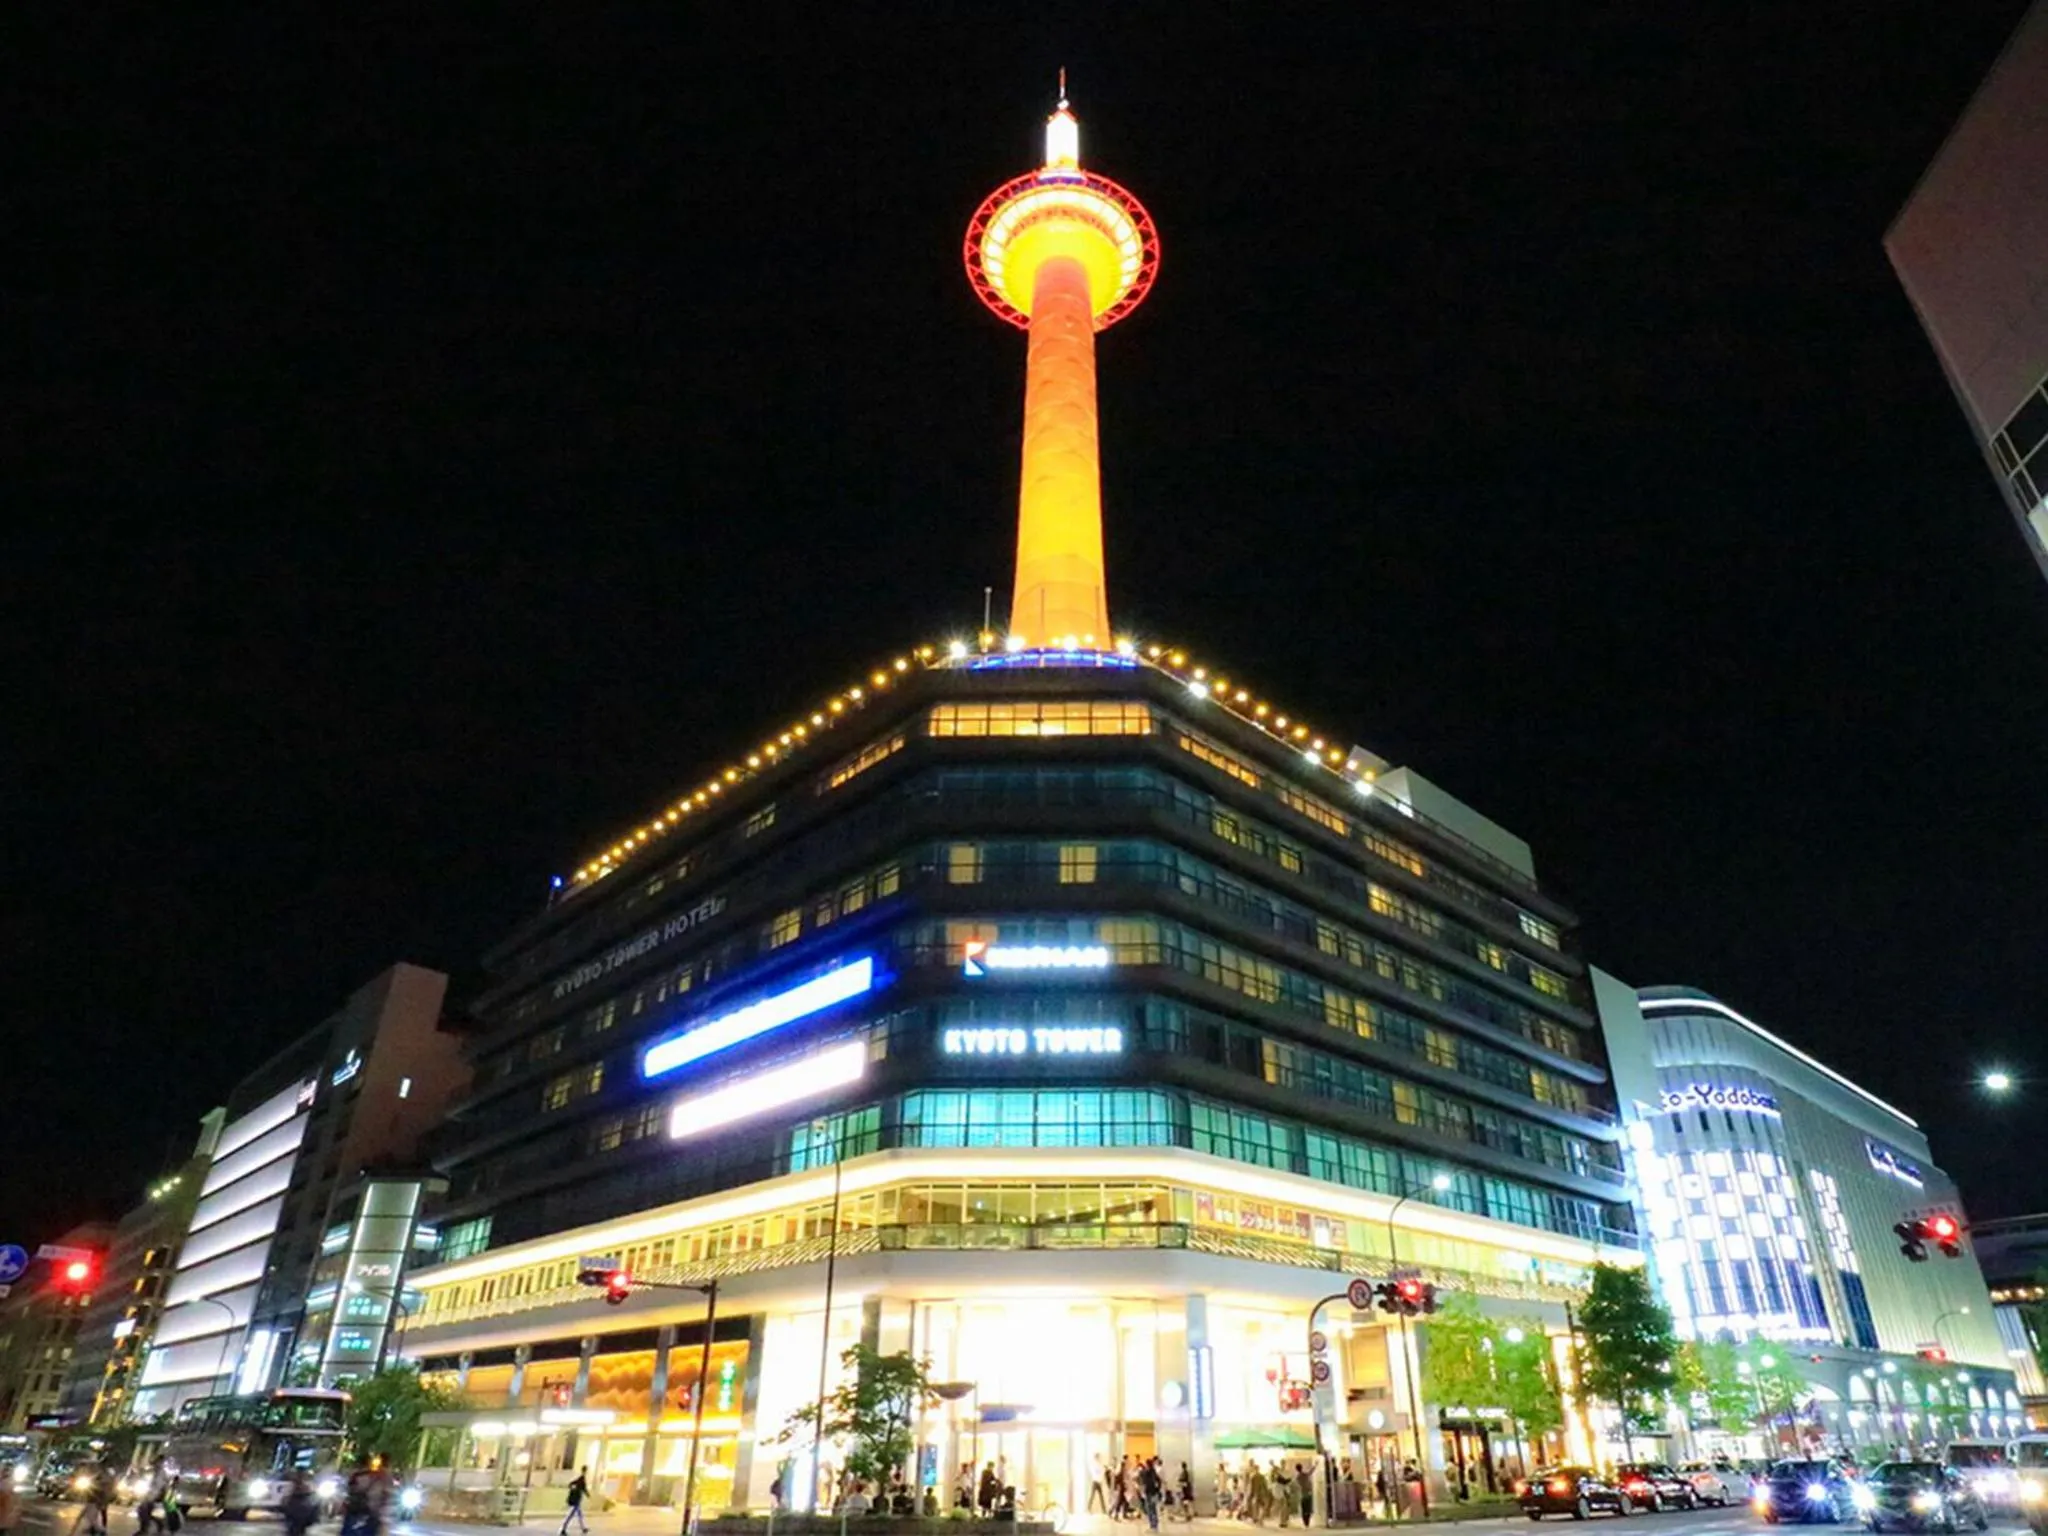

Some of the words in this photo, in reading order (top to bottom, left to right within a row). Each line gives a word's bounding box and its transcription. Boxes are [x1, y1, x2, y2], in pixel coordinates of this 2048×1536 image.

[552, 962, 602, 998] KYOTO
[605, 931, 660, 973] TOWER
[664, 897, 723, 941] HOTEL
[944, 1028, 1026, 1054] KYOTO
[1033, 1027, 1122, 1054] TOWER
